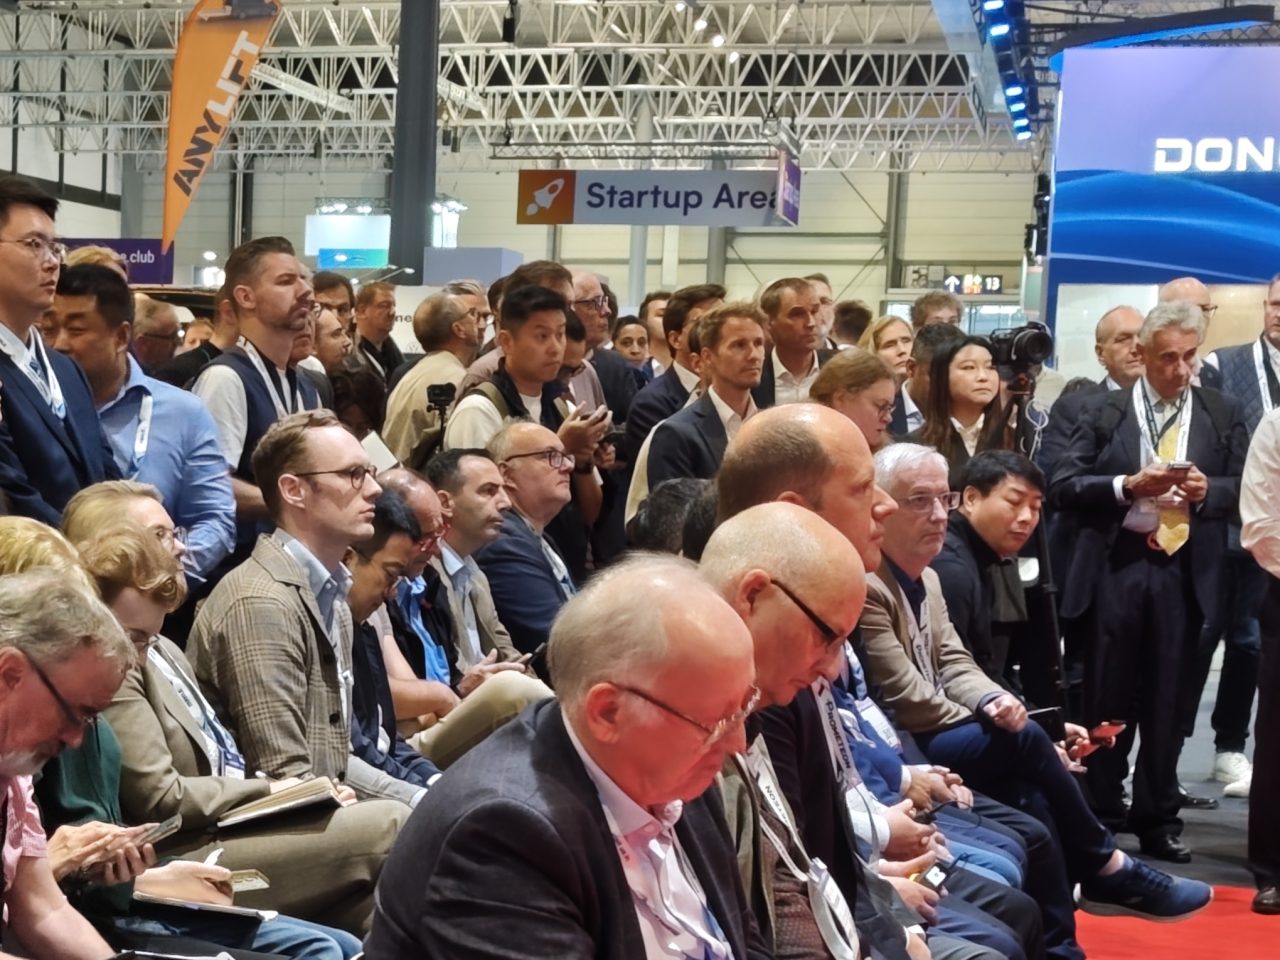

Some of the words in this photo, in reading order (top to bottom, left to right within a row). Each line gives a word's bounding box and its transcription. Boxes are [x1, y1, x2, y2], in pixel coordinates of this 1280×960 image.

[173, 30, 260, 197] ANYLIFT
[1154, 136, 1280, 172] DON
[587, 182, 703, 216] Startup
